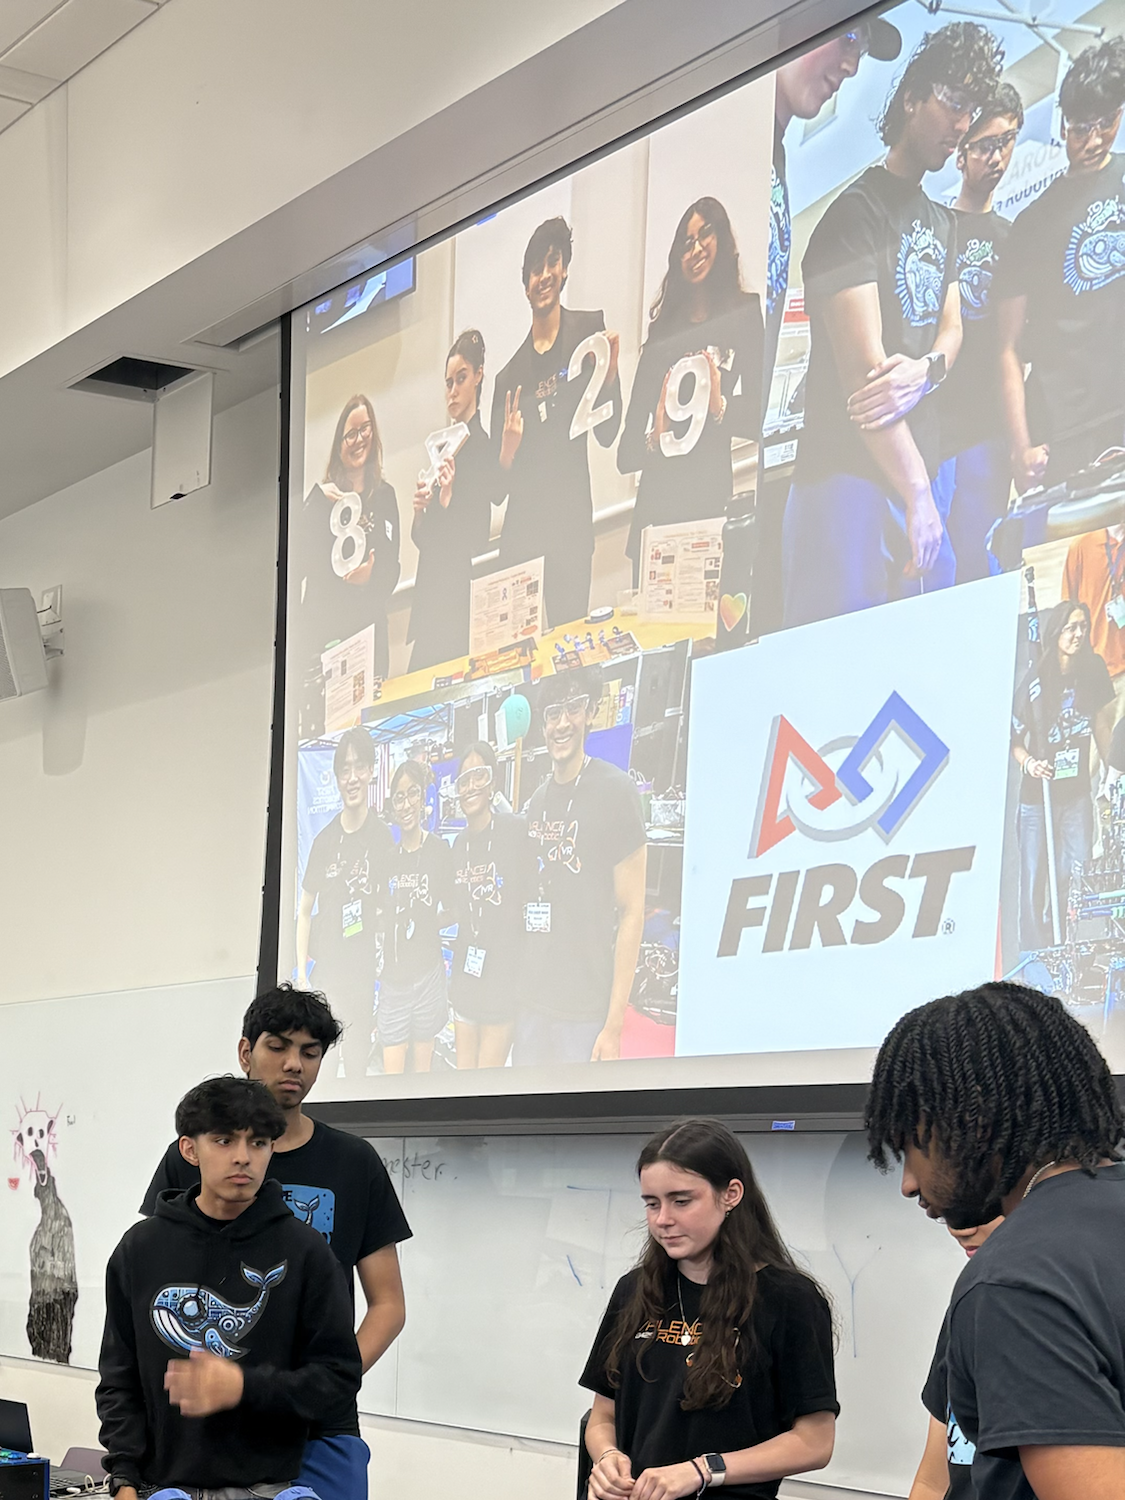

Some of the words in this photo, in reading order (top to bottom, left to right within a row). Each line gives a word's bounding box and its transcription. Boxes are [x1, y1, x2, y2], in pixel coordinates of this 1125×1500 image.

[567, 331, 613, 440] 2
[660, 354, 711, 457] 9
[330, 491, 366, 577] 8
[717, 846, 976, 957] FIRST
